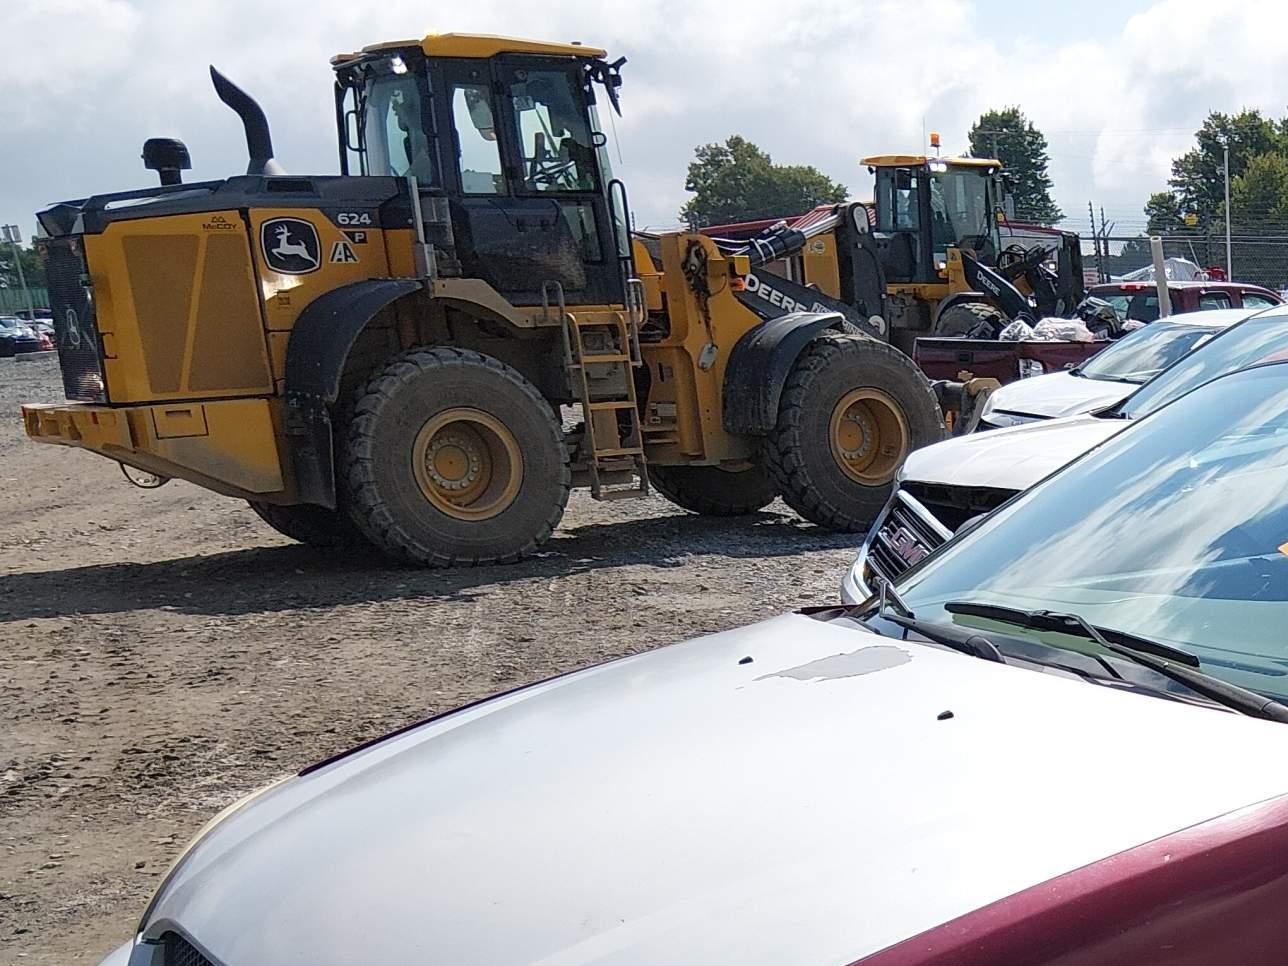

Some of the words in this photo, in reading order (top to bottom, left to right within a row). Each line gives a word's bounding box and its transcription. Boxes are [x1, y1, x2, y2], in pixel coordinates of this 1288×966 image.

[337, 213, 371, 225] 624
[354, 232, 365, 243] P
[976, 270, 1001, 296] DEERE
